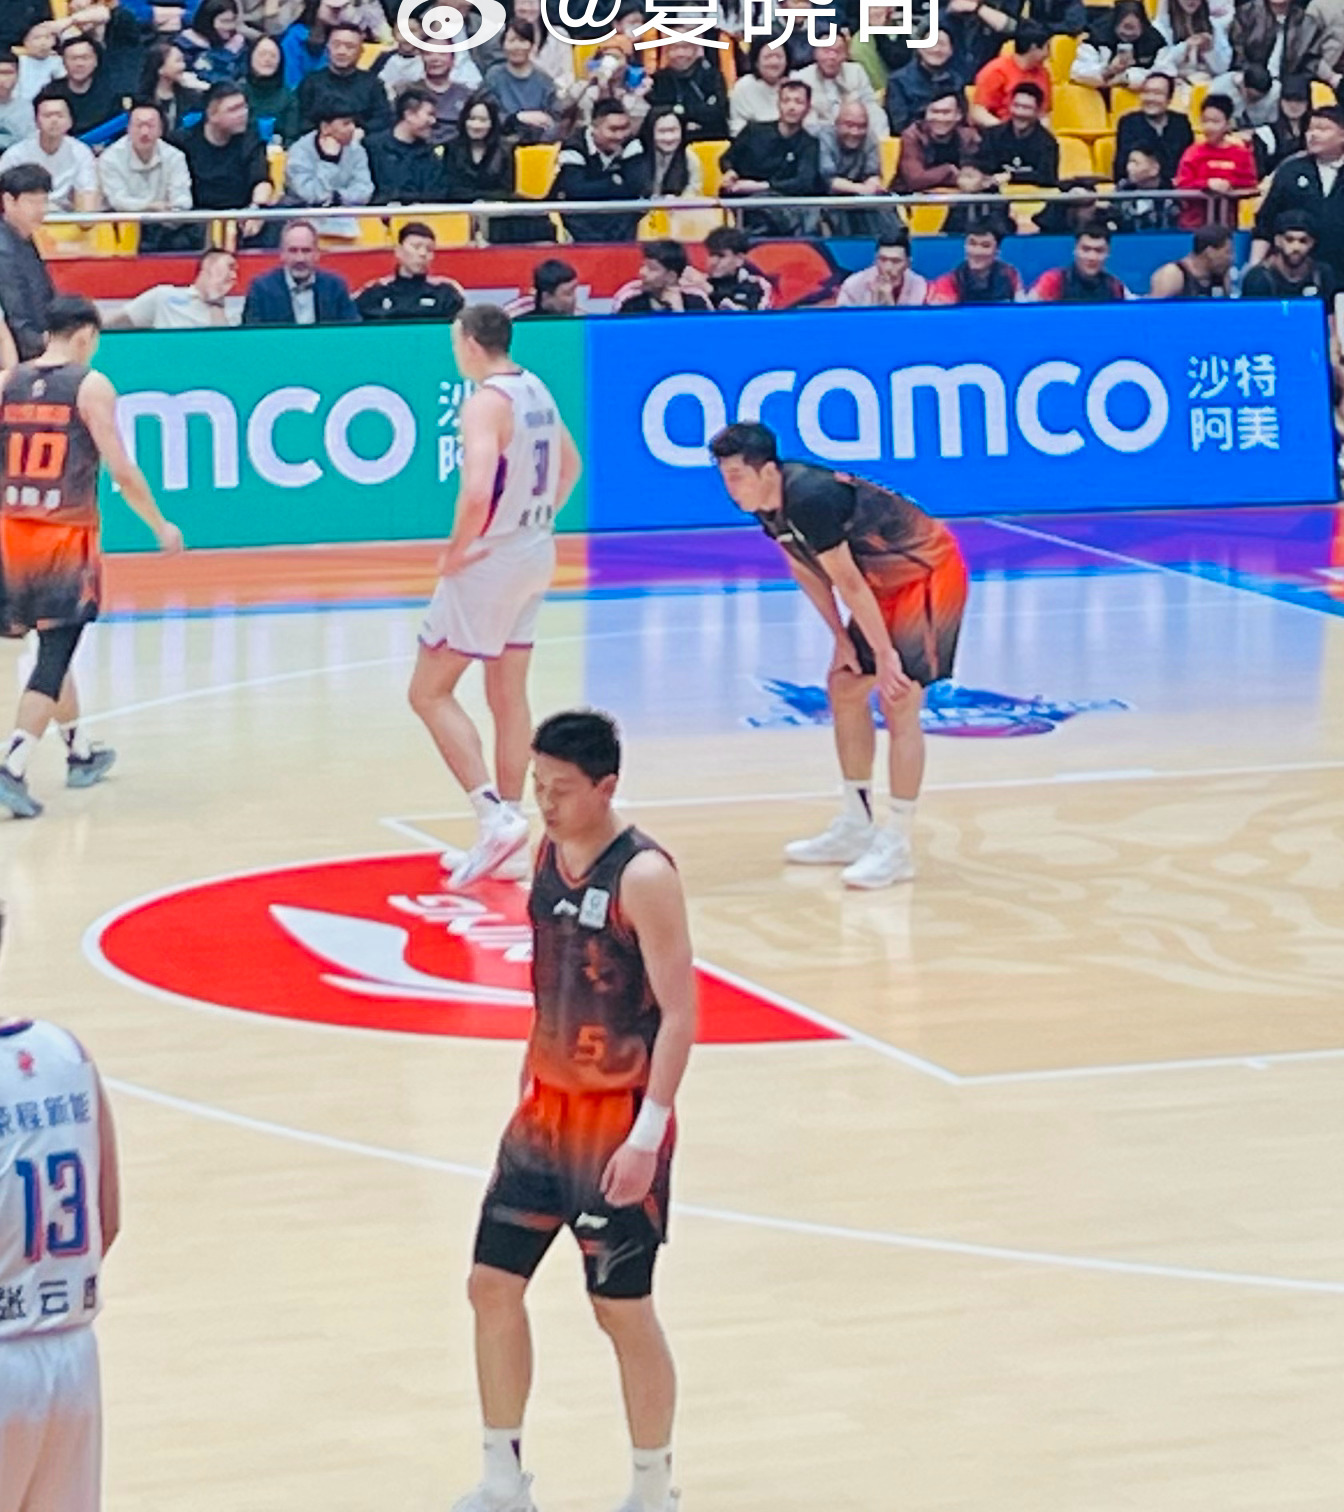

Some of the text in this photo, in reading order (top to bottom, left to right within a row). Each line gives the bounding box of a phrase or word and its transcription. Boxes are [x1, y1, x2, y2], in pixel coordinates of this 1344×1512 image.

[1188, 354, 1277, 399] 沙特
[641, 359, 1169, 468] aramco
[1190, 406, 1280, 452] 阿美
[8, 431, 69, 479] 10
[575, 1025, 607, 1064] 5
[15, 1149, 90, 1263] 13
